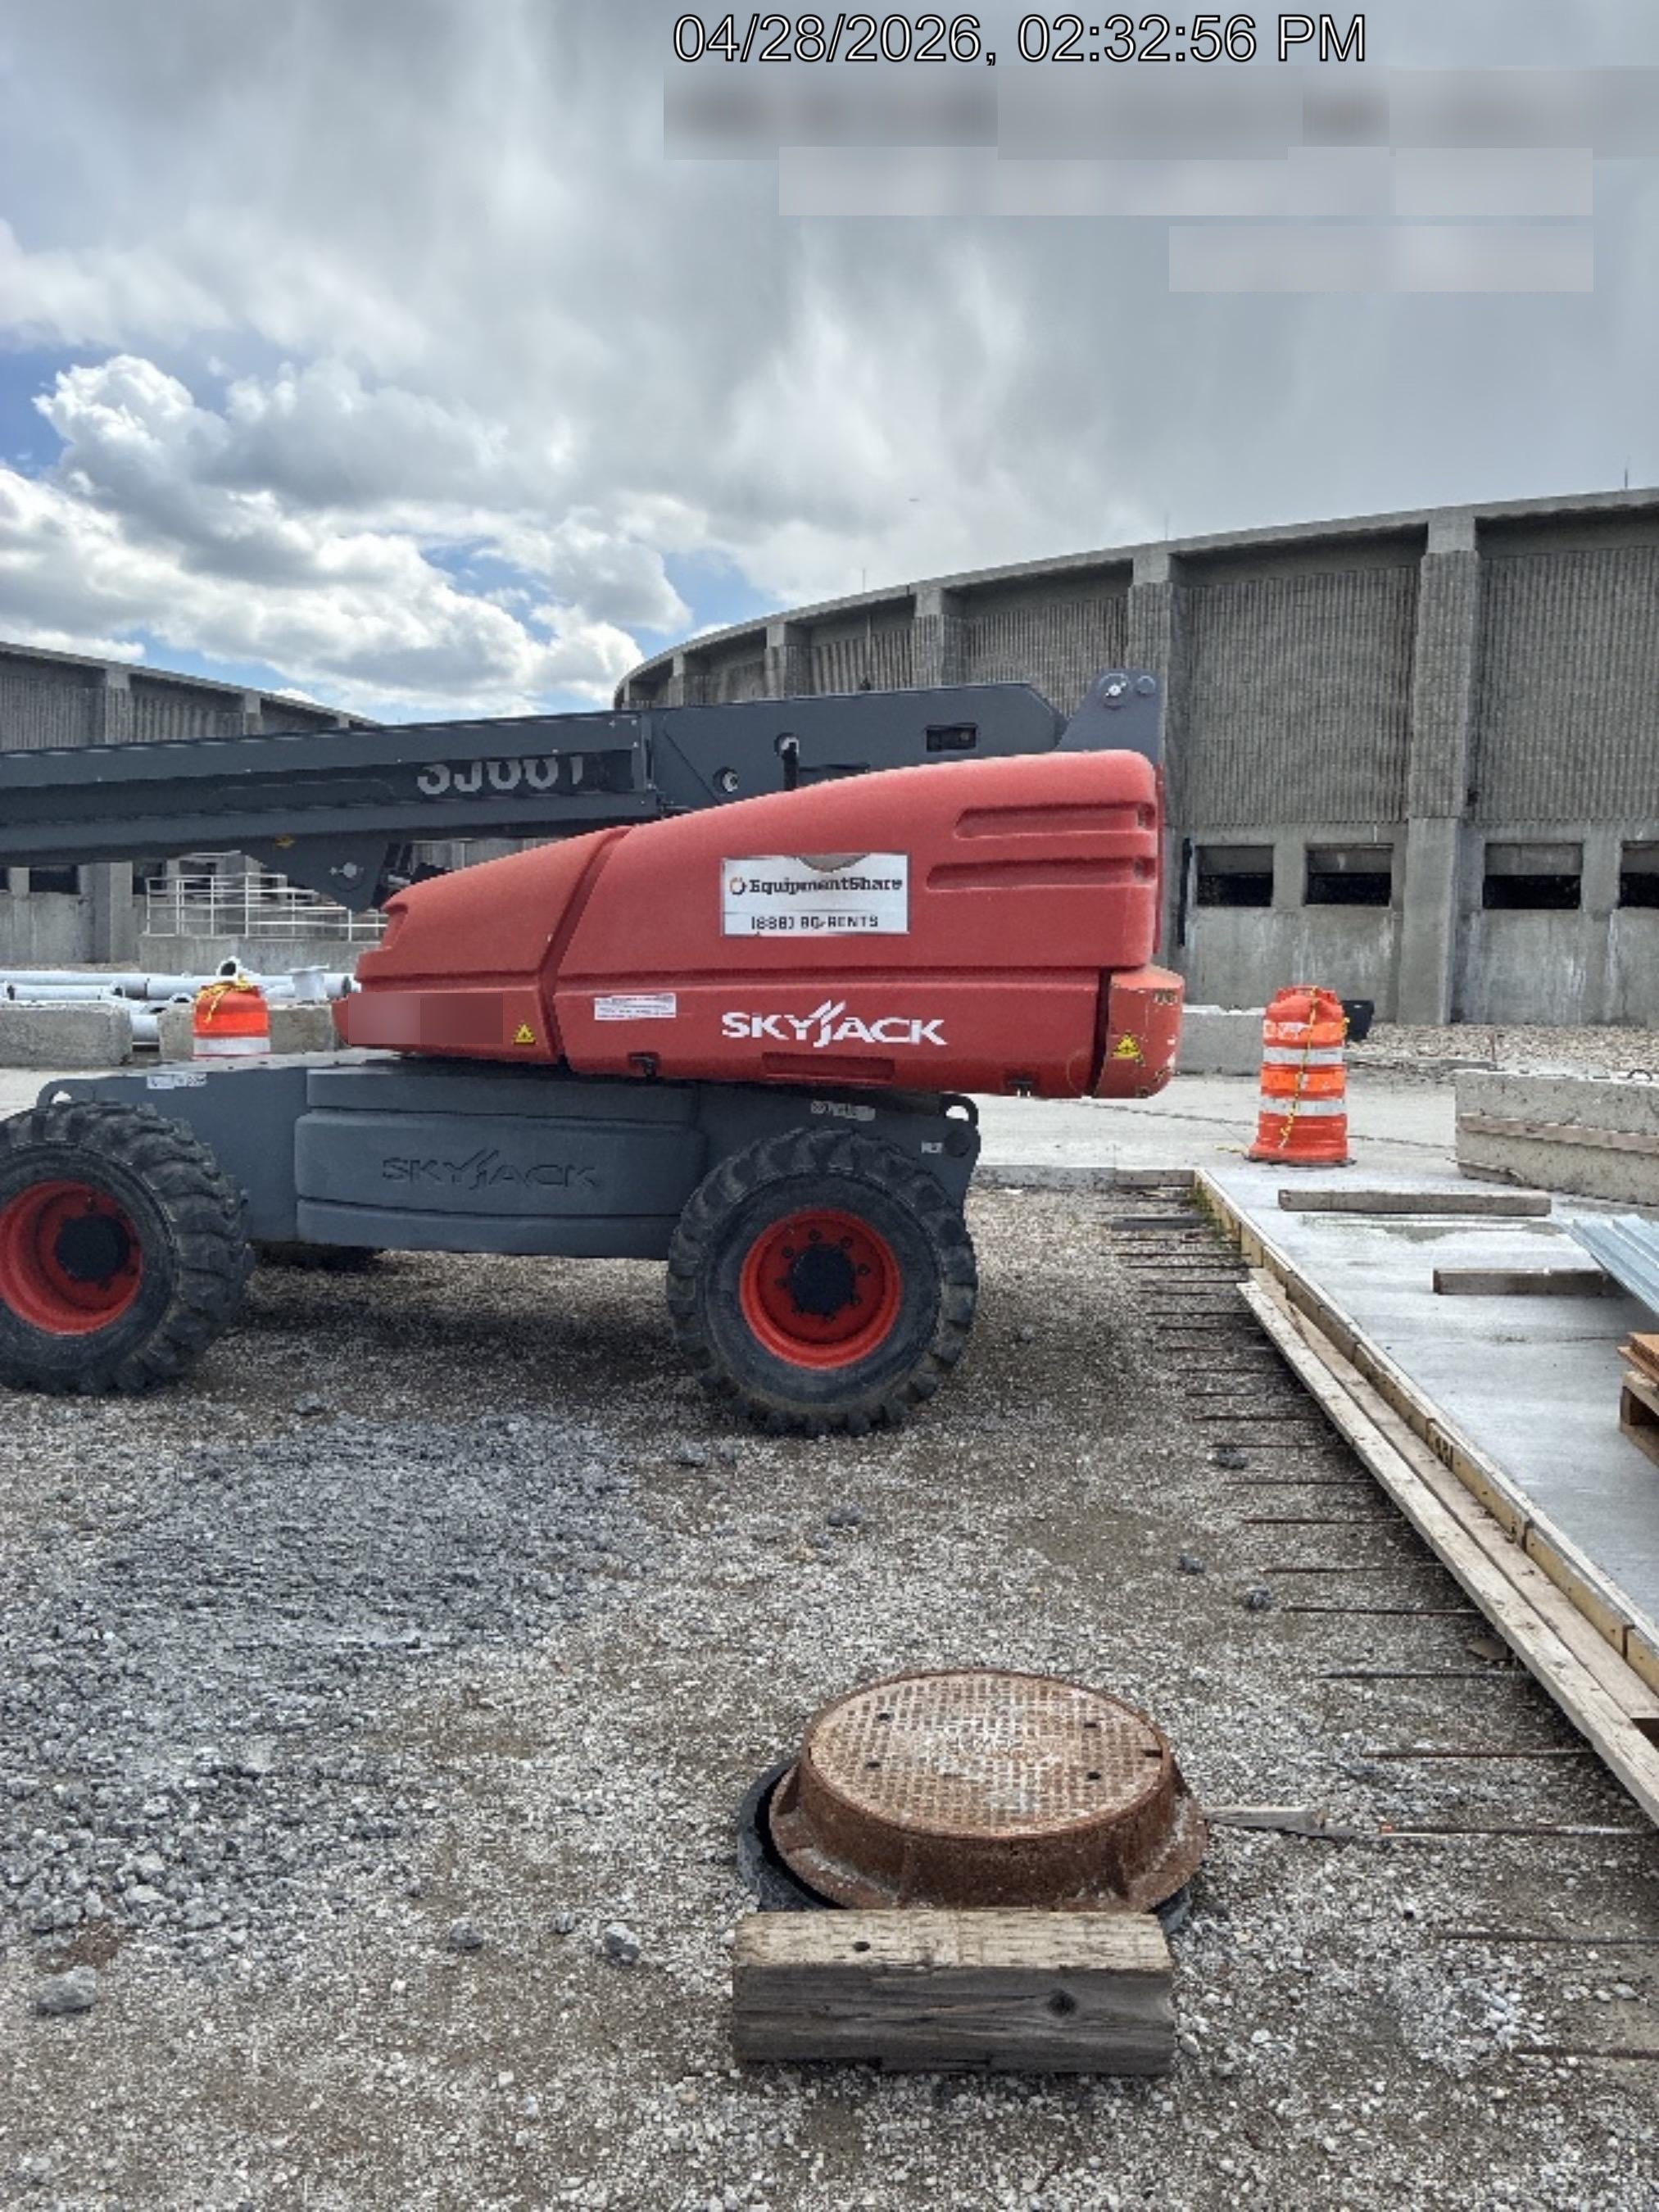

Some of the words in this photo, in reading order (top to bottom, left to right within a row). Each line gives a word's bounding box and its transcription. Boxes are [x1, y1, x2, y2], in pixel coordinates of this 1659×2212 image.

[749, 877, 903, 895] EquipmentShare
[721, 999, 948, 1048] SKYJACK
[382, 1149, 596, 1190] SKYJACK
